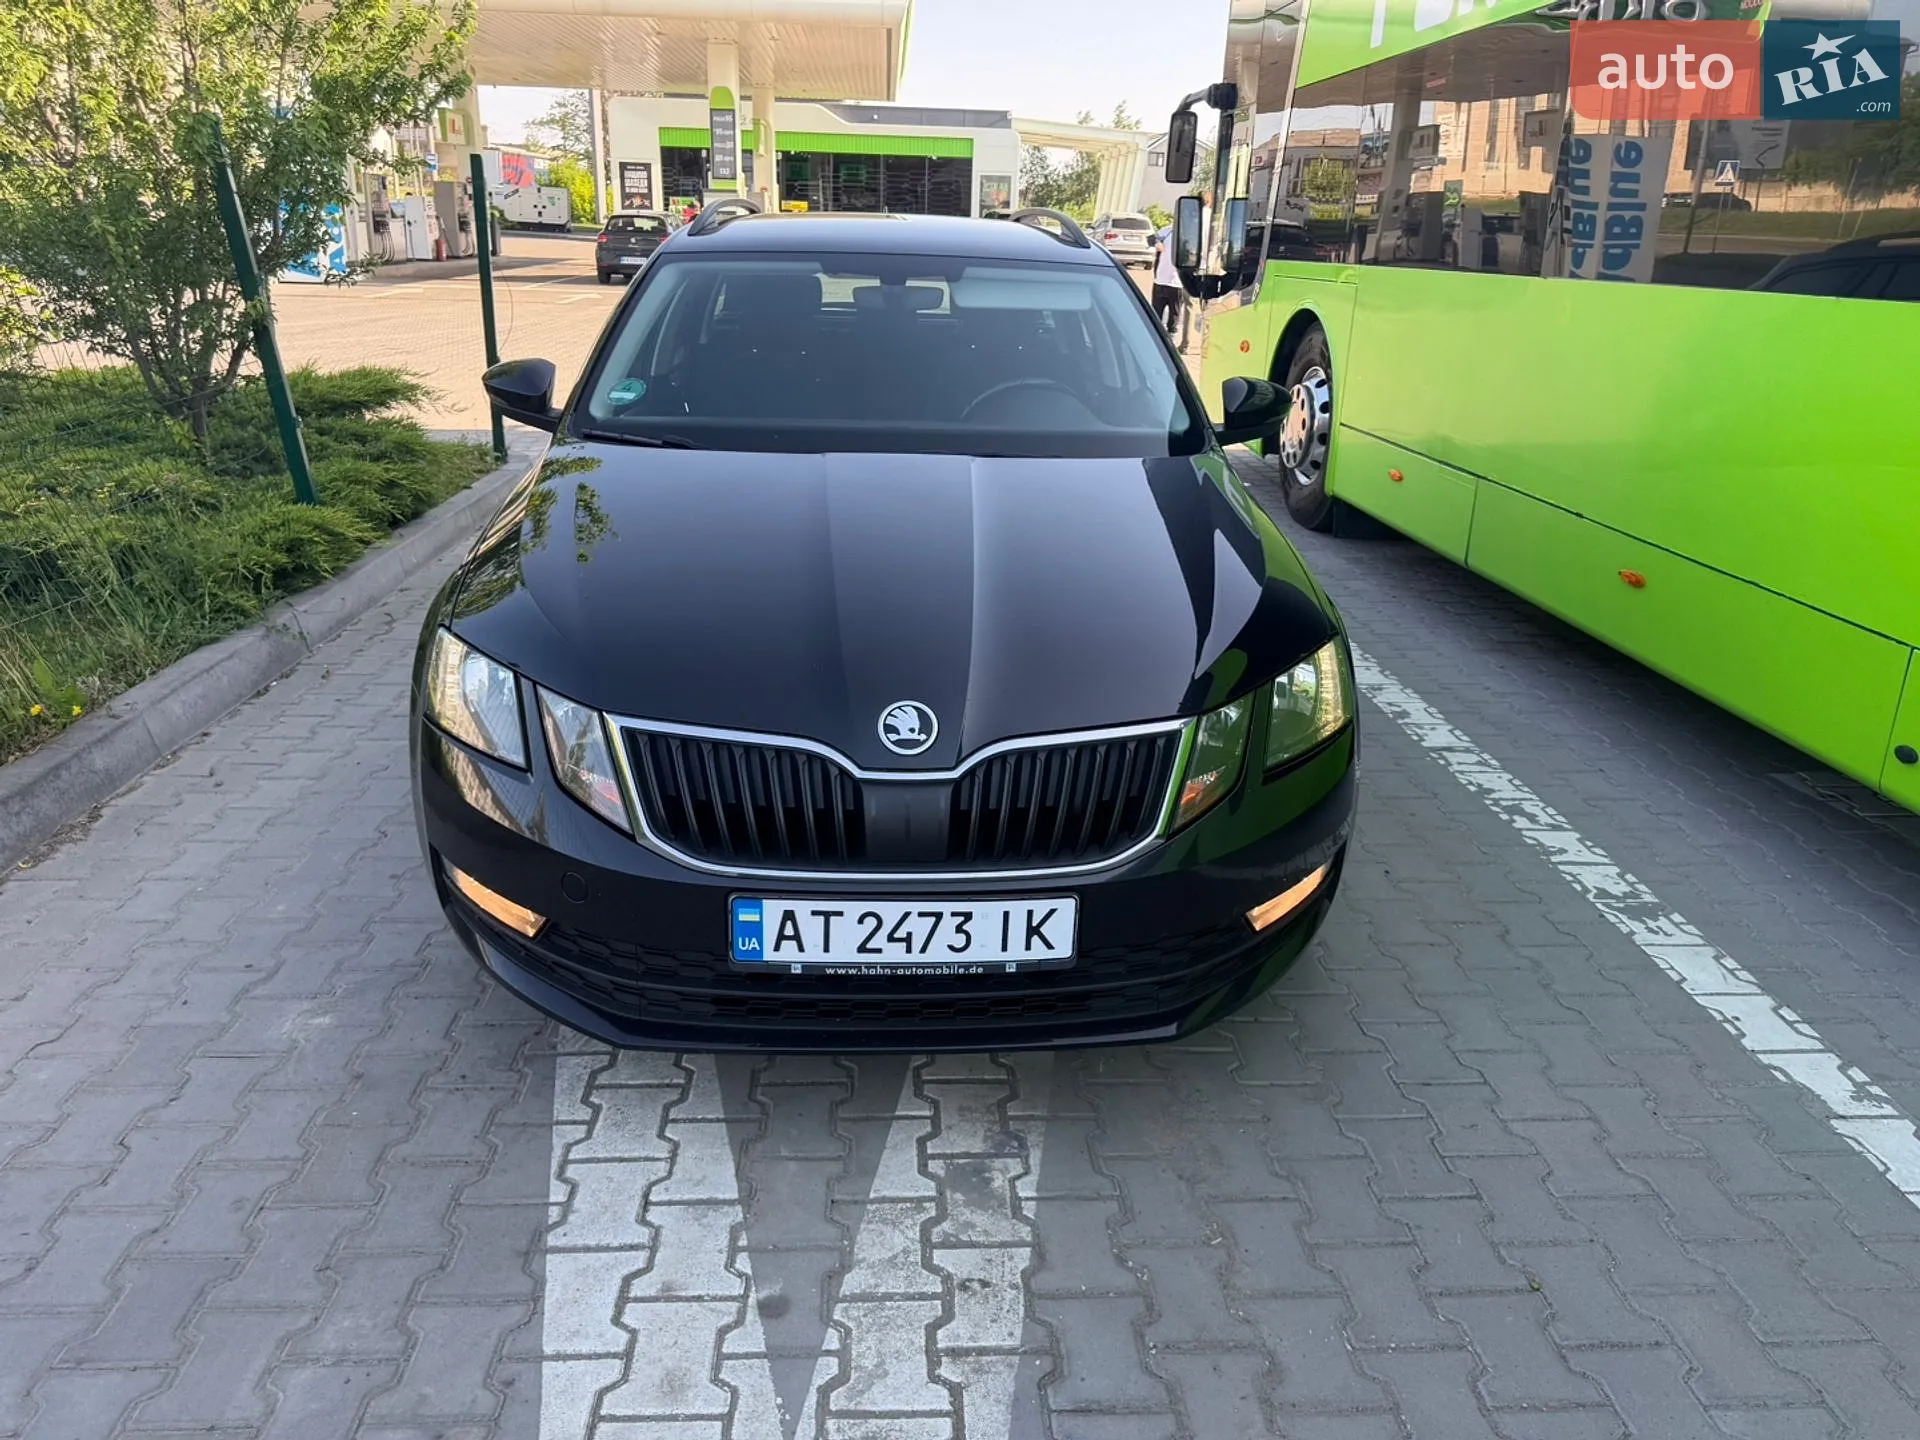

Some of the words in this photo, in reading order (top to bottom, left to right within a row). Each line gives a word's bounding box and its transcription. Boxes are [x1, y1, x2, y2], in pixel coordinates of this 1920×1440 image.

[773, 908, 844, 954] AT
[856, 910, 974, 955] 2473
[1000, 907, 1059, 953] IK
[738, 937, 760, 951] UA
[825, 965, 984, 977] www.hahn-automobile.de
